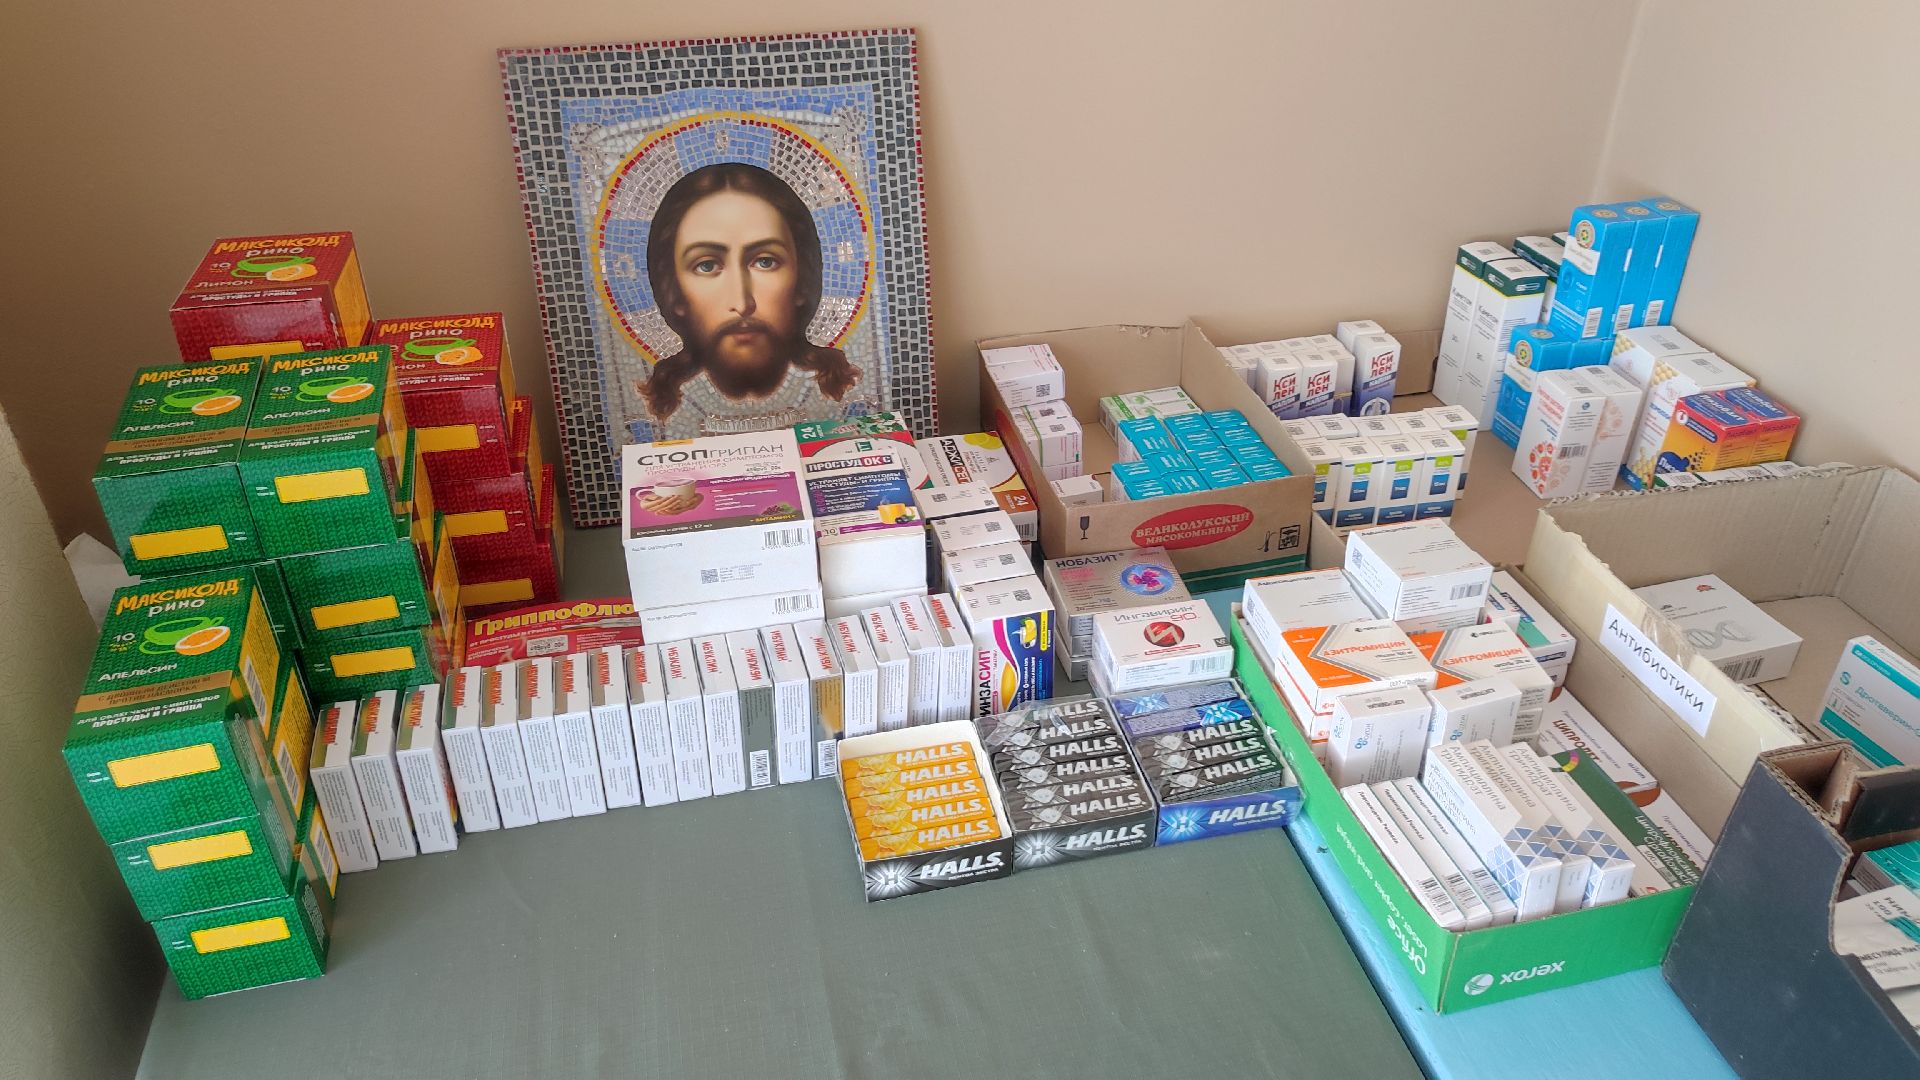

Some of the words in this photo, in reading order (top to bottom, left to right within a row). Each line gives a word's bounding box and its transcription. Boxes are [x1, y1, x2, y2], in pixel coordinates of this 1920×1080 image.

[637, 444, 784, 467] СТОПГРИПАН
[1016, 495, 1028, 506] 24
[1135, 512, 1250, 539] ВЕЛИКОЛУКСКИЙ
[1145, 524, 1238, 544] МЯСОКОМБИНАТ
[1056, 554, 1118, 568] НОБАЗИТ
[116, 579, 239, 615] МАКСИКОЛД
[1114, 606, 1193, 622] Ингавирин
[1170, 611, 1197, 622] 90
[113, 633, 135, 642] 10
[1323, 640, 1406, 657] АЗИТРОМИЦИН
[1442, 647, 1523, 665] АЗИТРОМИЦИН
[1608, 618, 1704, 713] Антибиотики
[976, 650, 991, 717] ИНЗАСИП
[92, 713, 150, 729] ПРОСТУДЫ
[162, 702, 203, 717] ГРИППА
[1440, 749, 1483, 797] тригидрат
[1448, 745, 1508, 812] Ампициллина
[1470, 748, 1514, 795] тригидрат
[1478, 744, 1537, 809] Ампициллина
[1507, 749, 1554, 797] тригидрат
[1516, 747, 1578, 812] Ампициллина
[1387, 915, 1426, 975] Office
[1500, 960, 1566, 985] xerox
